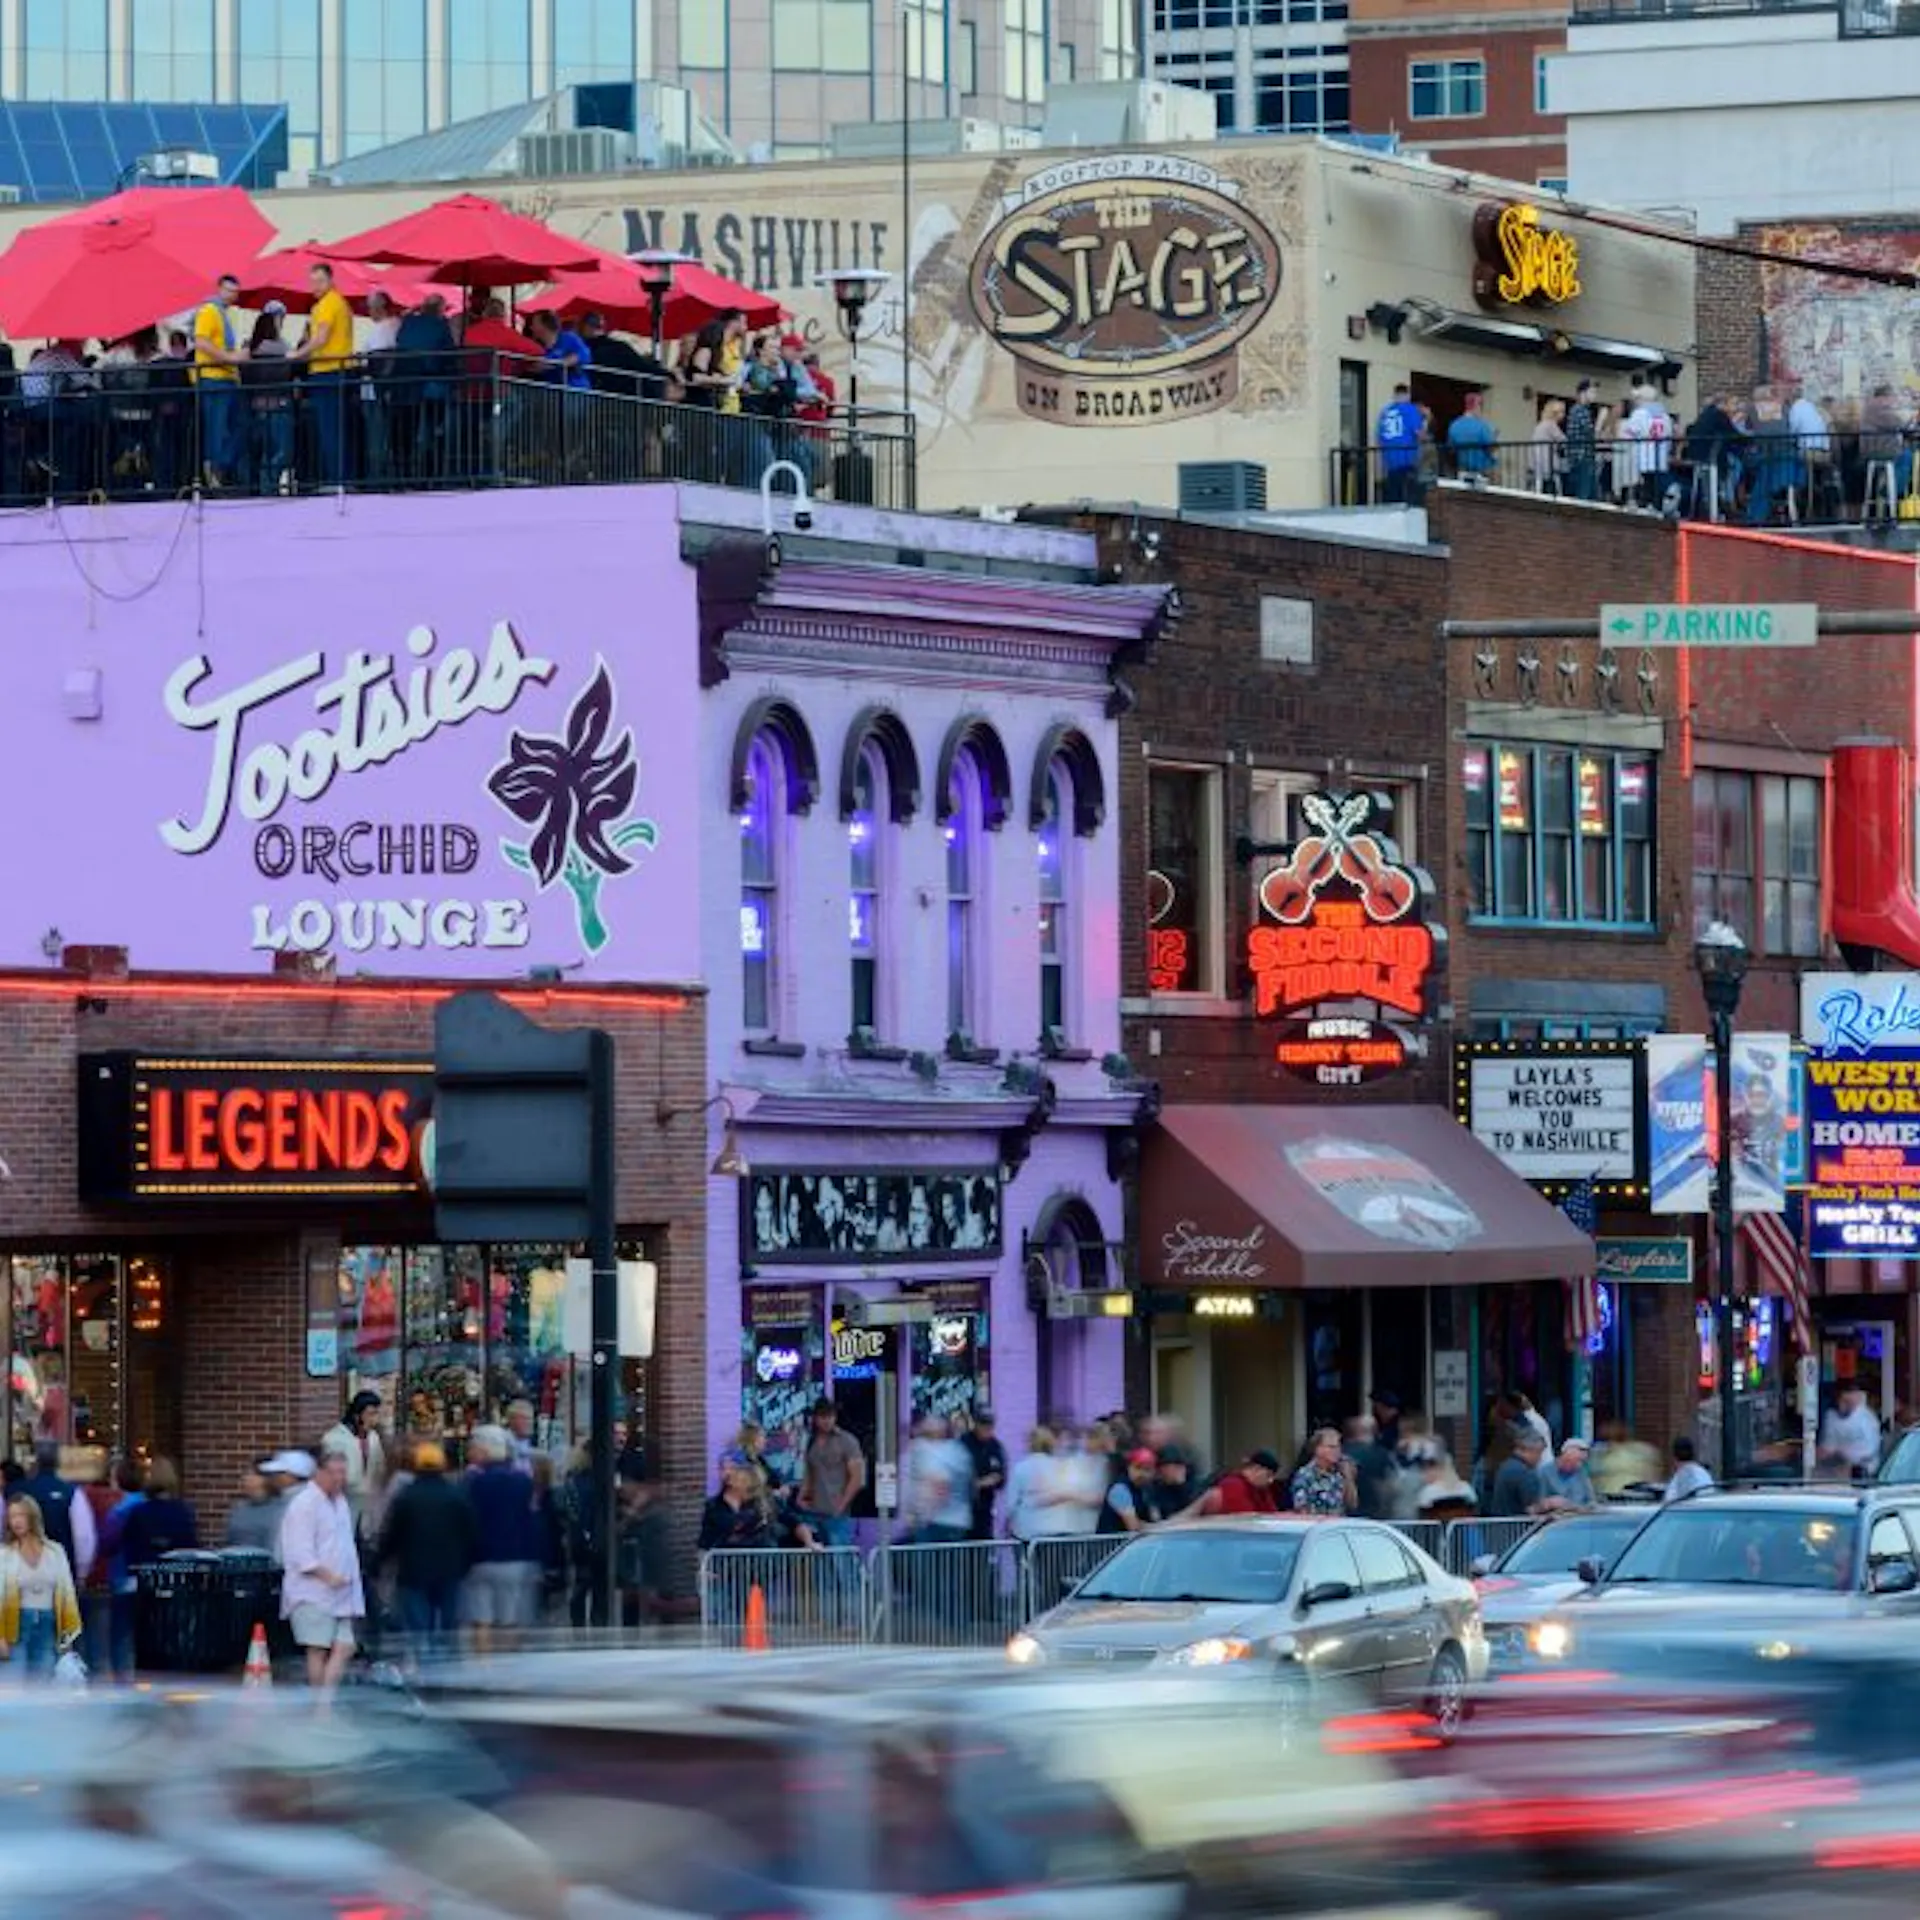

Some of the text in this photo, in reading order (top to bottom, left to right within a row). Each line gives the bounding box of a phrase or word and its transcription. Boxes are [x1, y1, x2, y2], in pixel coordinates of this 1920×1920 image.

[1028, 159, 1212, 194] ROOFTOP PATIO
[993, 214, 1265, 337] STAGE
[1025, 371, 1228, 417] ON BROADWAY
[1643, 608, 1772, 641] PARKING
[160, 620, 558, 855] Tootsies
[254, 822, 479, 883] ORCHID
[250, 898, 531, 952] LOUNGE
[1249, 926, 1431, 972] SECOND
[1514, 1067, 1594, 1086] LAYLA'S
[1508, 1089, 1602, 1107] WELCOMES
[1832, 1088, 1920, 1113] WOR
[148, 1088, 411, 1171] LEGENDS
[1539, 1110, 1574, 1128] YOU
[1493, 1132, 1620, 1150] TO NASHVILLE
[1162, 1220, 1265, 1252] Second
[1841, 1224, 1917, 1245] GRILL
[1195, 1296, 1254, 1316] ATM
